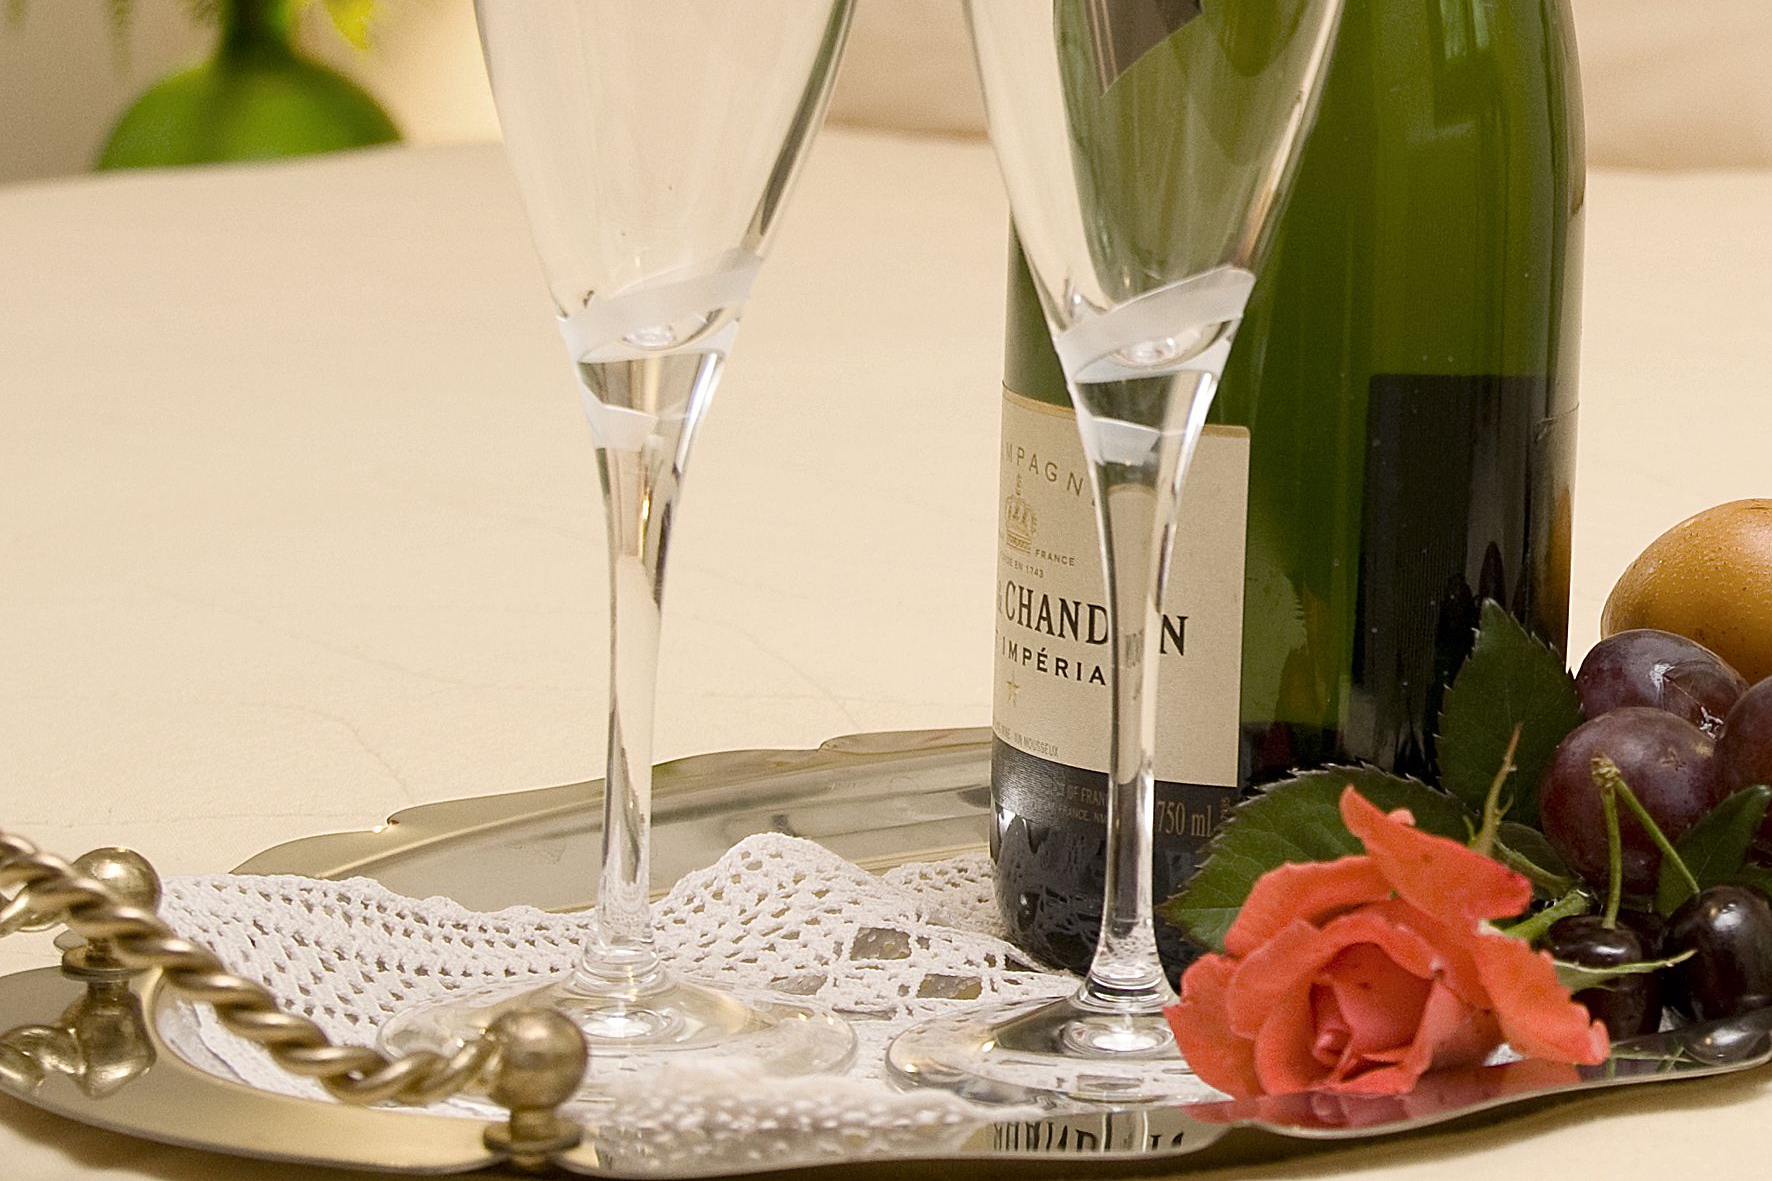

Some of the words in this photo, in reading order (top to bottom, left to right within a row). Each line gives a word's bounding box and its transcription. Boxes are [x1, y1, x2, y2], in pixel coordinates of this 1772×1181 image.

[1005, 442, 1096, 508] MPAGN
[1025, 564, 1044, 579] 1743
[1035, 548, 1075, 567] FRANCE
[1005, 579, 1189, 657] CHANDN
[1002, 635, 1107, 686] IMPÉRIA
[1157, 800, 1186, 836] 750
[1191, 804, 1212, 838] ml
